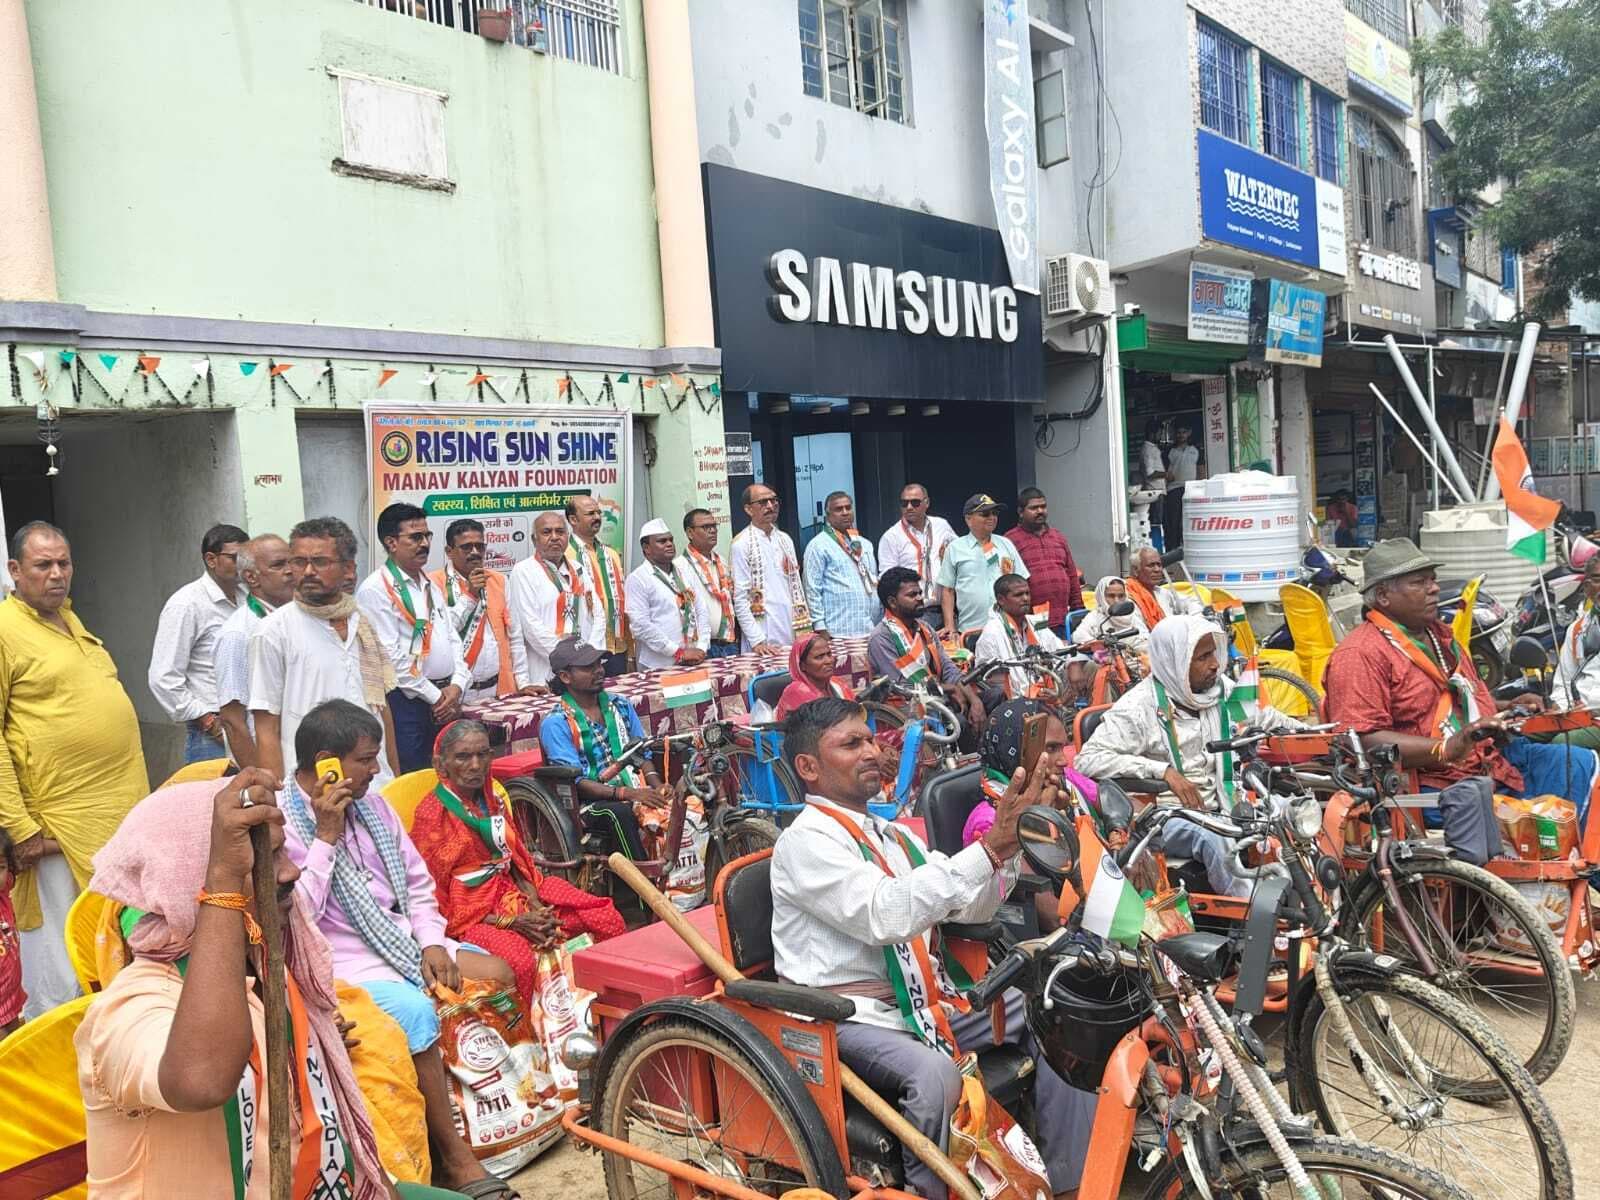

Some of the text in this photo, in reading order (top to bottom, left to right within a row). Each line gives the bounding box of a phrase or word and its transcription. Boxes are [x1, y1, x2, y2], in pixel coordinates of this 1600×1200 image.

[995, 38, 1030, 261] Galaxy AI
[1224, 167, 1300, 220] WATERTEC
[767, 248, 1019, 343] SAMSUNG
[415, 431, 617, 465] RISING SUN SHINE
[383, 468, 617, 491] MANAV KALYAN FOUNDATION
[470, 495, 500, 510] शिक्षित
[503, 494, 516, 509] एवं
[1190, 517, 1254, 531] Tufline
[896, 943, 932, 1033] MY INDIA
[240, 1087, 254, 1152] LOVE
[476, 1094, 512, 1118] ATTA
[320, 1096, 339, 1172] INDIA
